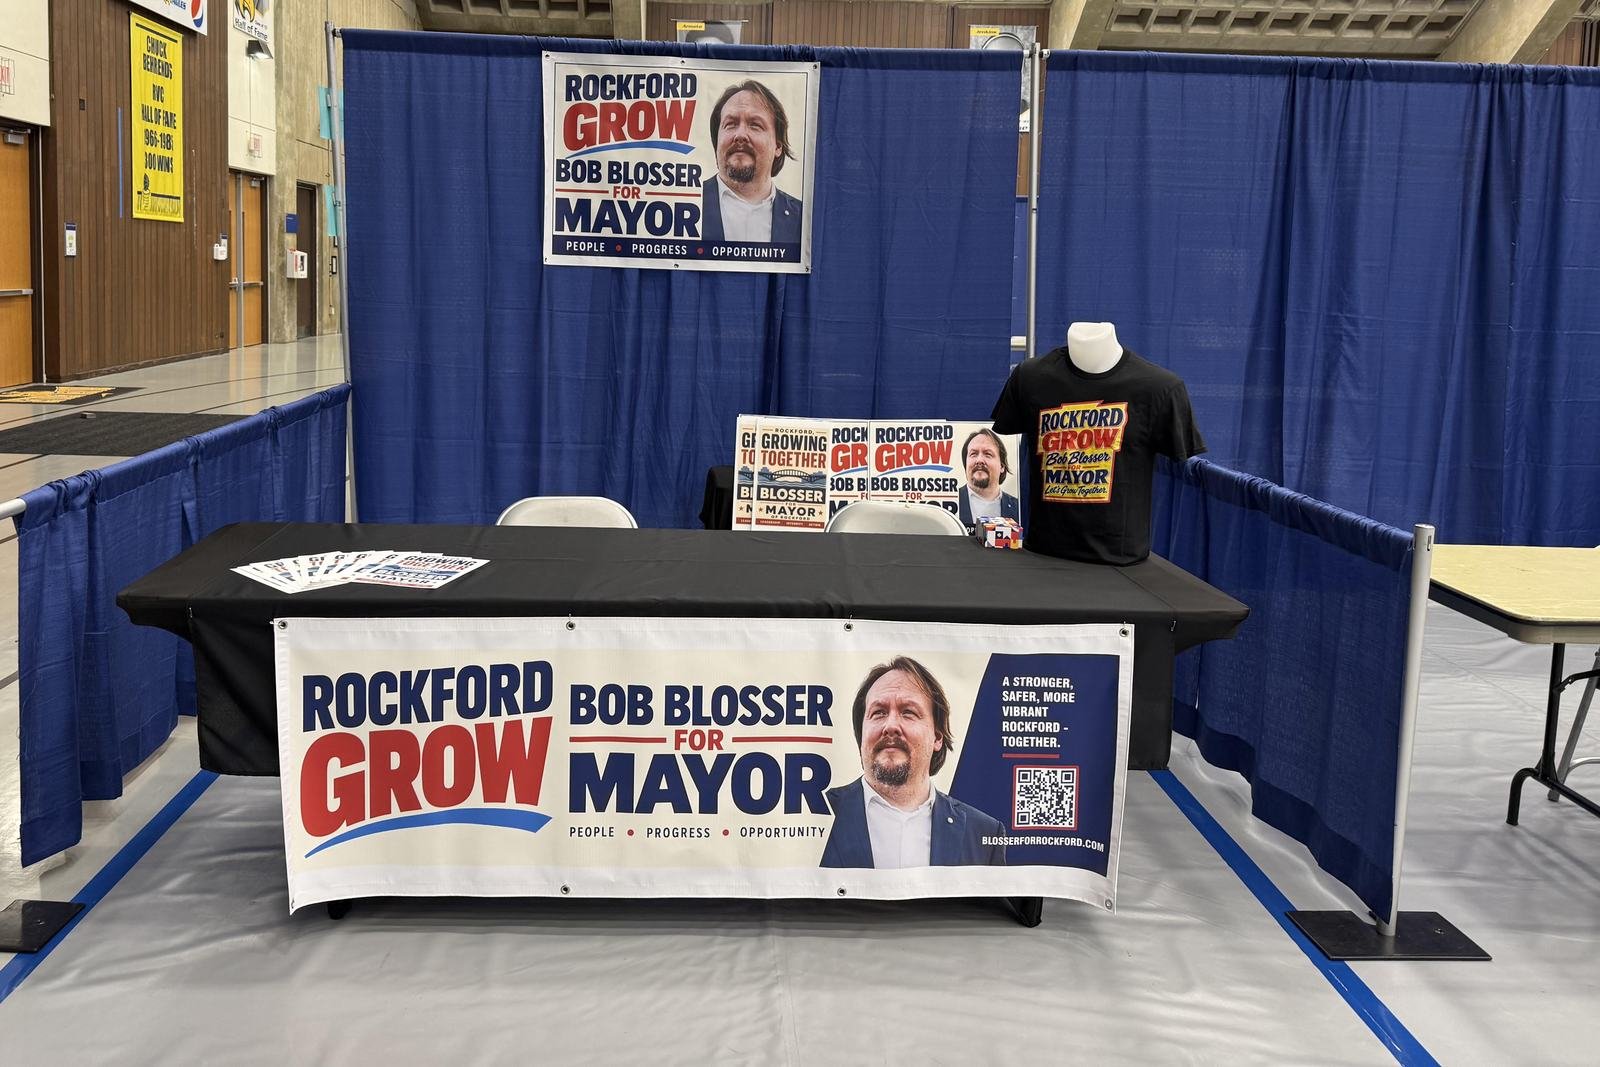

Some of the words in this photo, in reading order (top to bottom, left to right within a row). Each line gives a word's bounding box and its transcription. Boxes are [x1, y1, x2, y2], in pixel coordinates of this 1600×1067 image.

[565, 73, 697, 102] ROCKFORD
[563, 100, 697, 150] GROW
[556, 159, 601, 184] BOB
[608, 162, 702, 188] BLOSSER
[613, 186, 640, 199] FOR
[554, 198, 700, 238] MAYOR
[566, 241, 605, 252] PEOPLE
[632, 244, 687, 255] PROGRESS
[712, 246, 786, 258] OPPORTUNITY
[1041, 407, 1124, 435] ROCKFORD
[761, 433, 827, 452] GROWING
[832, 427, 868, 444] ROCK
[876, 425, 953, 444] ROCKFORD
[1042, 428, 1120, 452] GROW
[761, 450, 826, 468] TOGETHER
[831, 443, 868, 472] GR
[875, 440, 953, 472] GROW
[1046, 452, 1067, 466] Bob
[1068, 451, 1110, 464] Blosser
[871, 477, 898, 491] BOB
[902, 478, 958, 492] BLOSSER
[1046, 469, 1108, 484] MAYOR
[760, 487, 823, 502] BLOSSER
[1045, 485, 1060, 494] Let's
[1061, 485, 1078, 496] Grow
[766, 505, 816, 516] MAYOR
[1002, 677, 1010, 687] A
[1013, 677, 1074, 690] STRONGER,
[302, 660, 553, 733] ROCKFORD
[1002, 691, 1040, 703] SAFER,
[1044, 692, 1075, 703] MORE
[570, 684, 654, 727] BOB
[664, 684, 833, 728] BLOSSER
[1002, 706, 1048, 717] VIBRANT
[1002, 722, 1060, 732] ROCKFORD
[674, 729, 724, 751] FOR
[1002, 736, 1061, 748] TOGETHER.
[300, 716, 553, 837] GROW
[569, 751, 832, 815] MAYOR
[569, 826, 614, 837] PEOPLE
[647, 828, 710, 838] PROGRESS
[740, 826, 825, 838] OPPORTUNITY
[982, 836, 1104, 852] BLOSSERFORROCKFORD.COM
